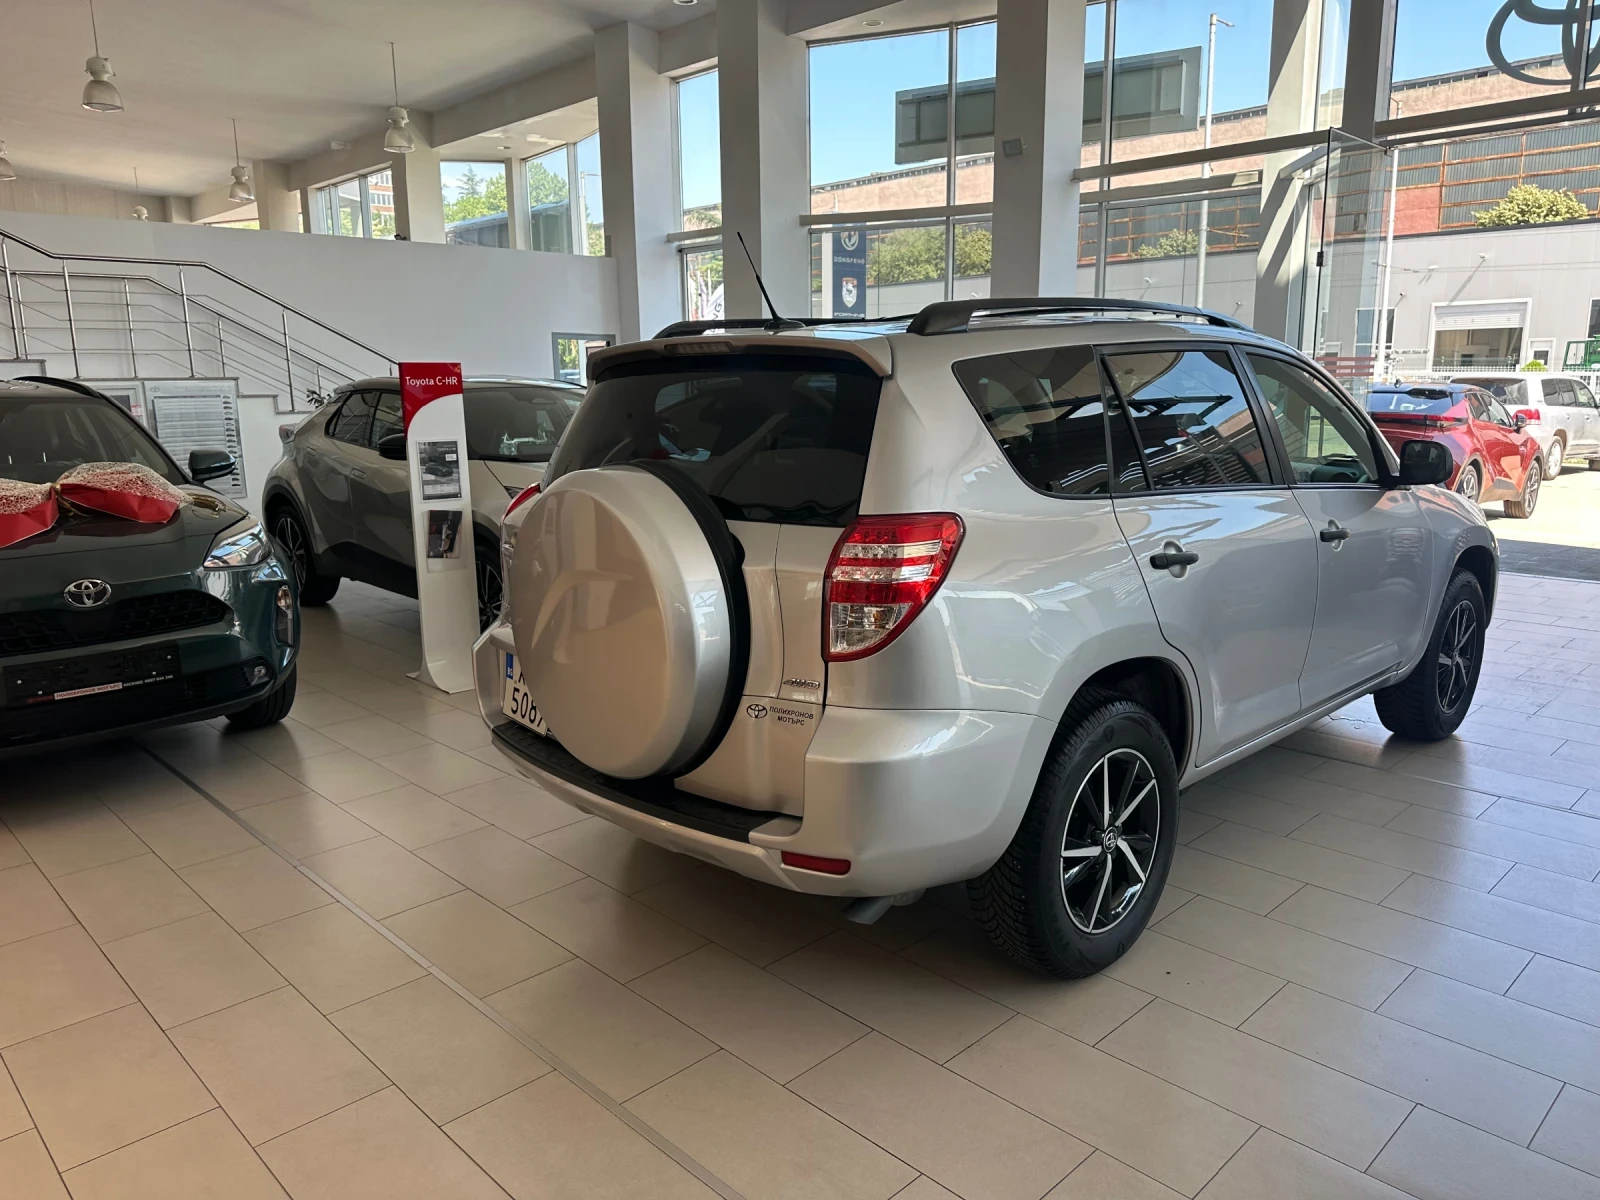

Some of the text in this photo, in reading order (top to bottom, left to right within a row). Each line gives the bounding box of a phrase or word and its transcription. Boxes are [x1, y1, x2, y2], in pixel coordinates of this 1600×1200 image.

[405, 376, 458, 387] Toyota C-HR
[769, 706, 814, 719] ПОЛИХРОНОВ
[777, 716, 805, 726] МОТЪРС
